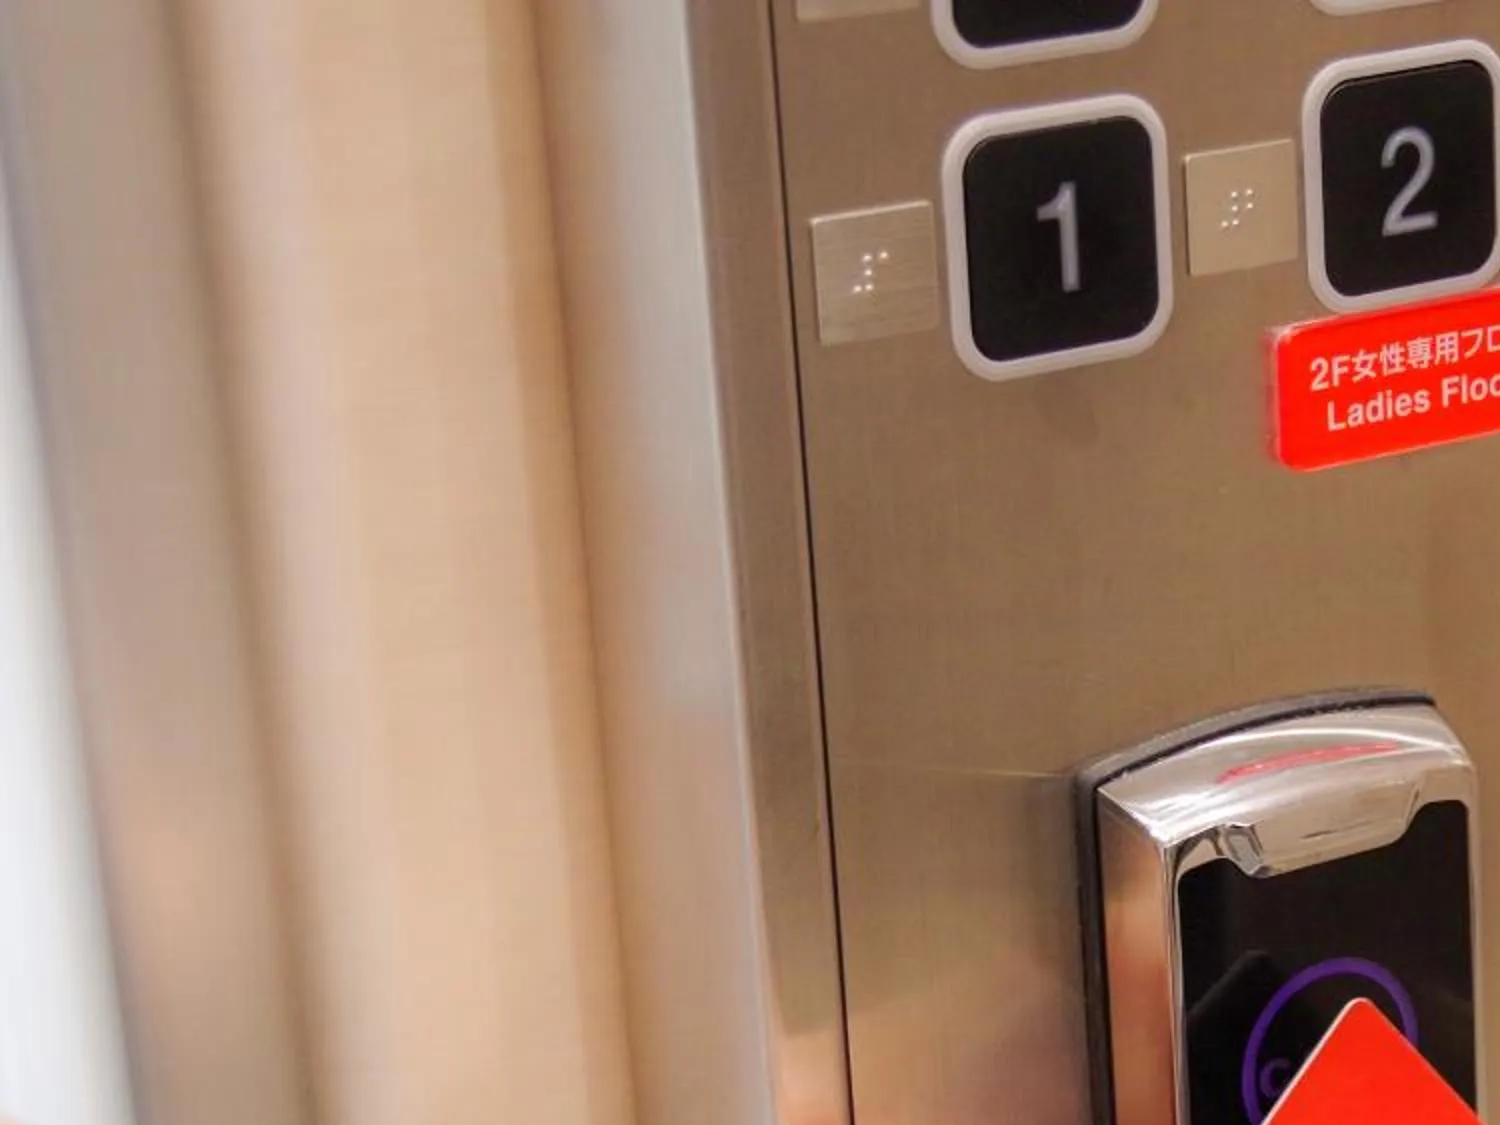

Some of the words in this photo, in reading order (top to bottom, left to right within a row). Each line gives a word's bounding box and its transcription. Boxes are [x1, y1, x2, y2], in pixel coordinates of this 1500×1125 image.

[1036, 181, 1081, 293] 1
[1379, 126, 1439, 238] 2
[1326, 389, 1431, 432] Ladies
